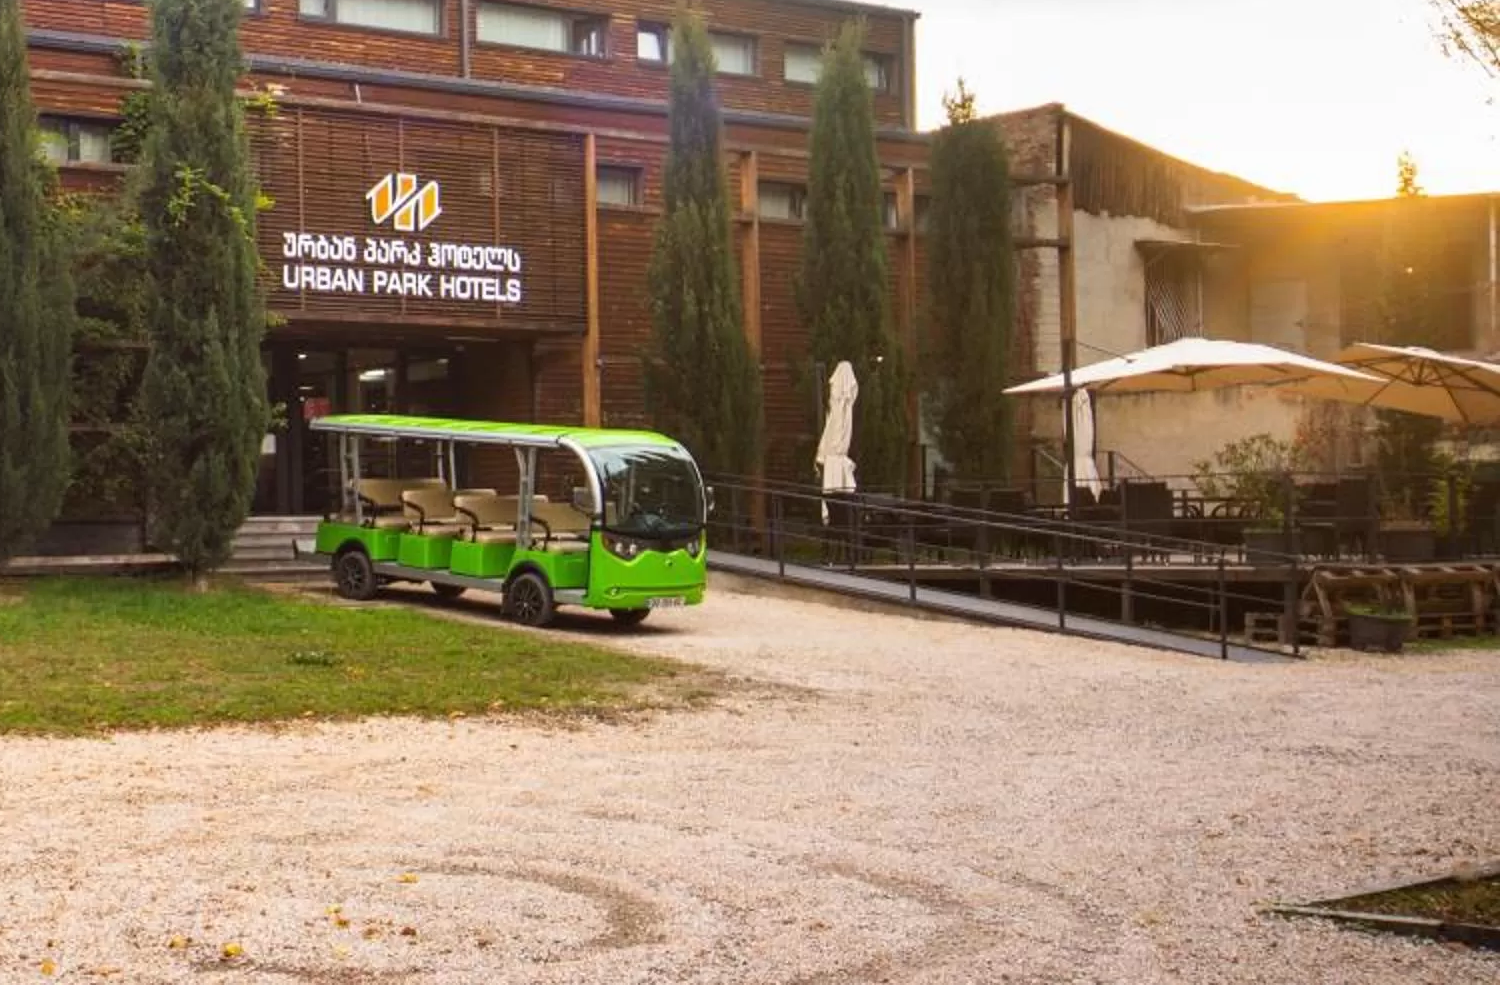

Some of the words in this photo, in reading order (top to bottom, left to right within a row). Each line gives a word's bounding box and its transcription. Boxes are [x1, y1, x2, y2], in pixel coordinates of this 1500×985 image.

[283, 264, 364, 293] URBAN
[373, 270, 433, 297] PARK
[439, 274, 521, 303] HOTELS
